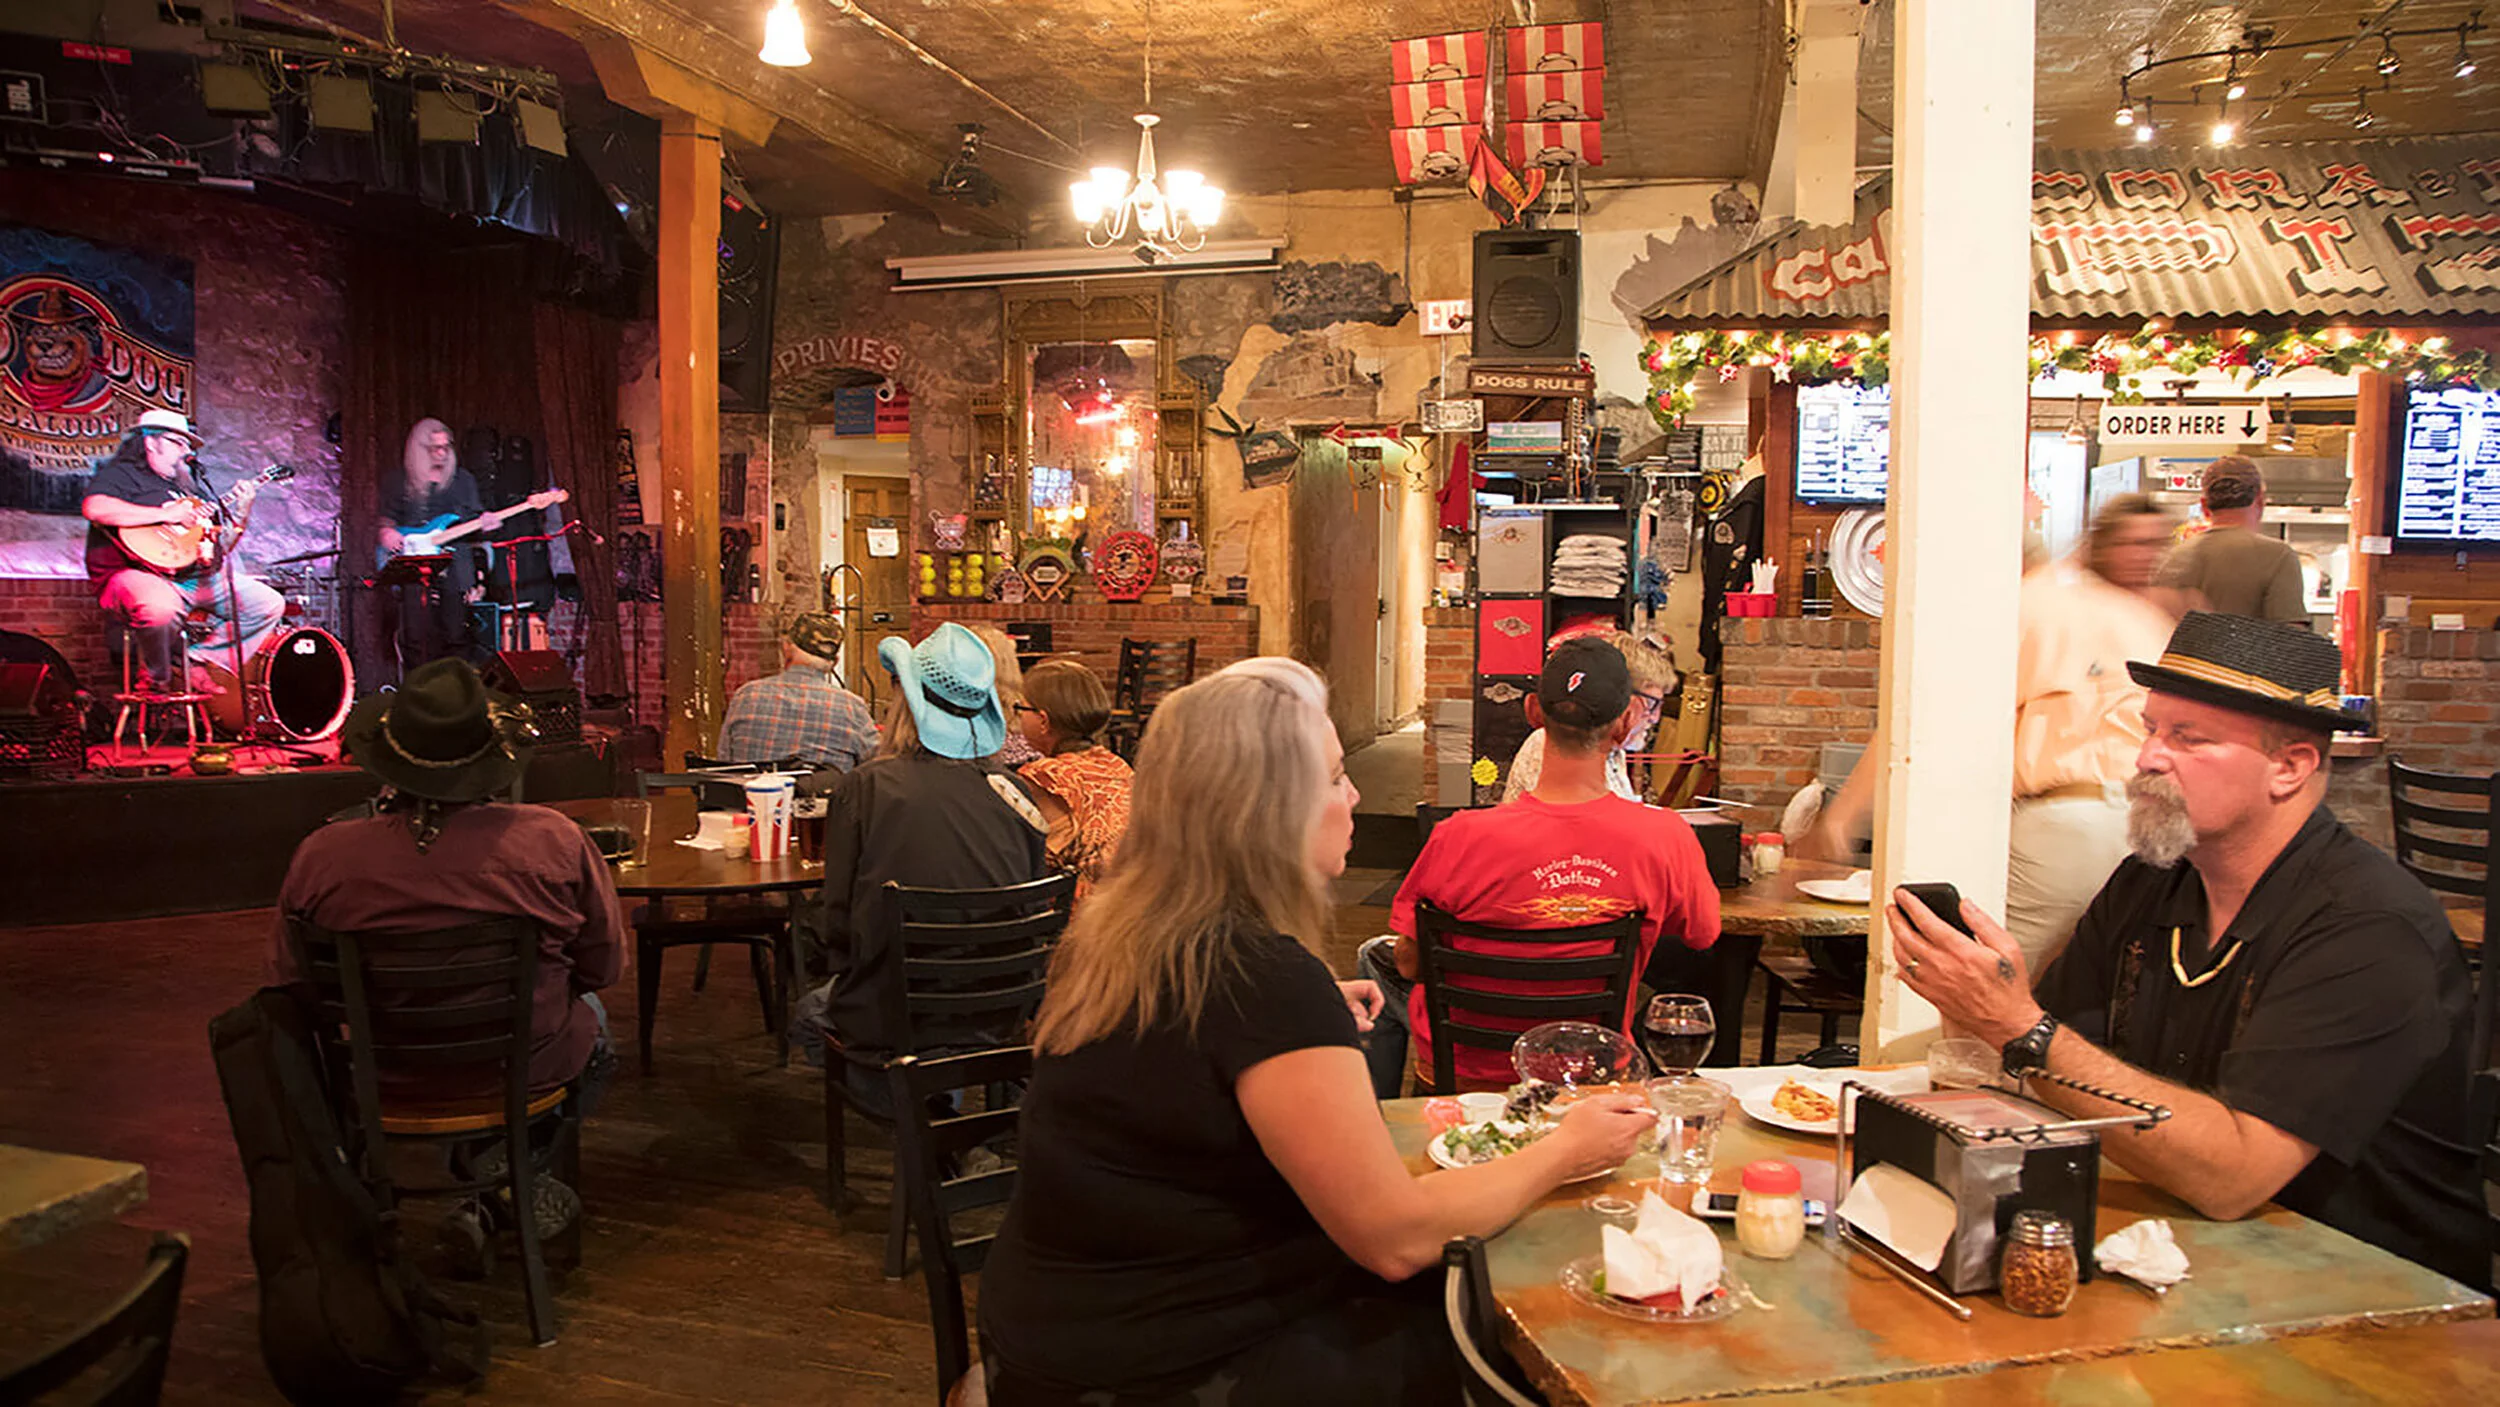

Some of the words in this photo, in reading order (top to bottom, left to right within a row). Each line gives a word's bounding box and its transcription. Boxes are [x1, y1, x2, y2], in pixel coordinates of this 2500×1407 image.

[103, 332, 187, 408] DOG
[777, 337, 900, 375] PRIVIES
[1473, 375, 1528, 389] DOGS
[1533, 378, 1587, 392] RULE
[0, 401, 120, 439] SALOON
[2107, 415, 2172, 435] ORDER
[2178, 415, 2226, 435] HERE
[1548, 870, 1602, 888] Dothan
